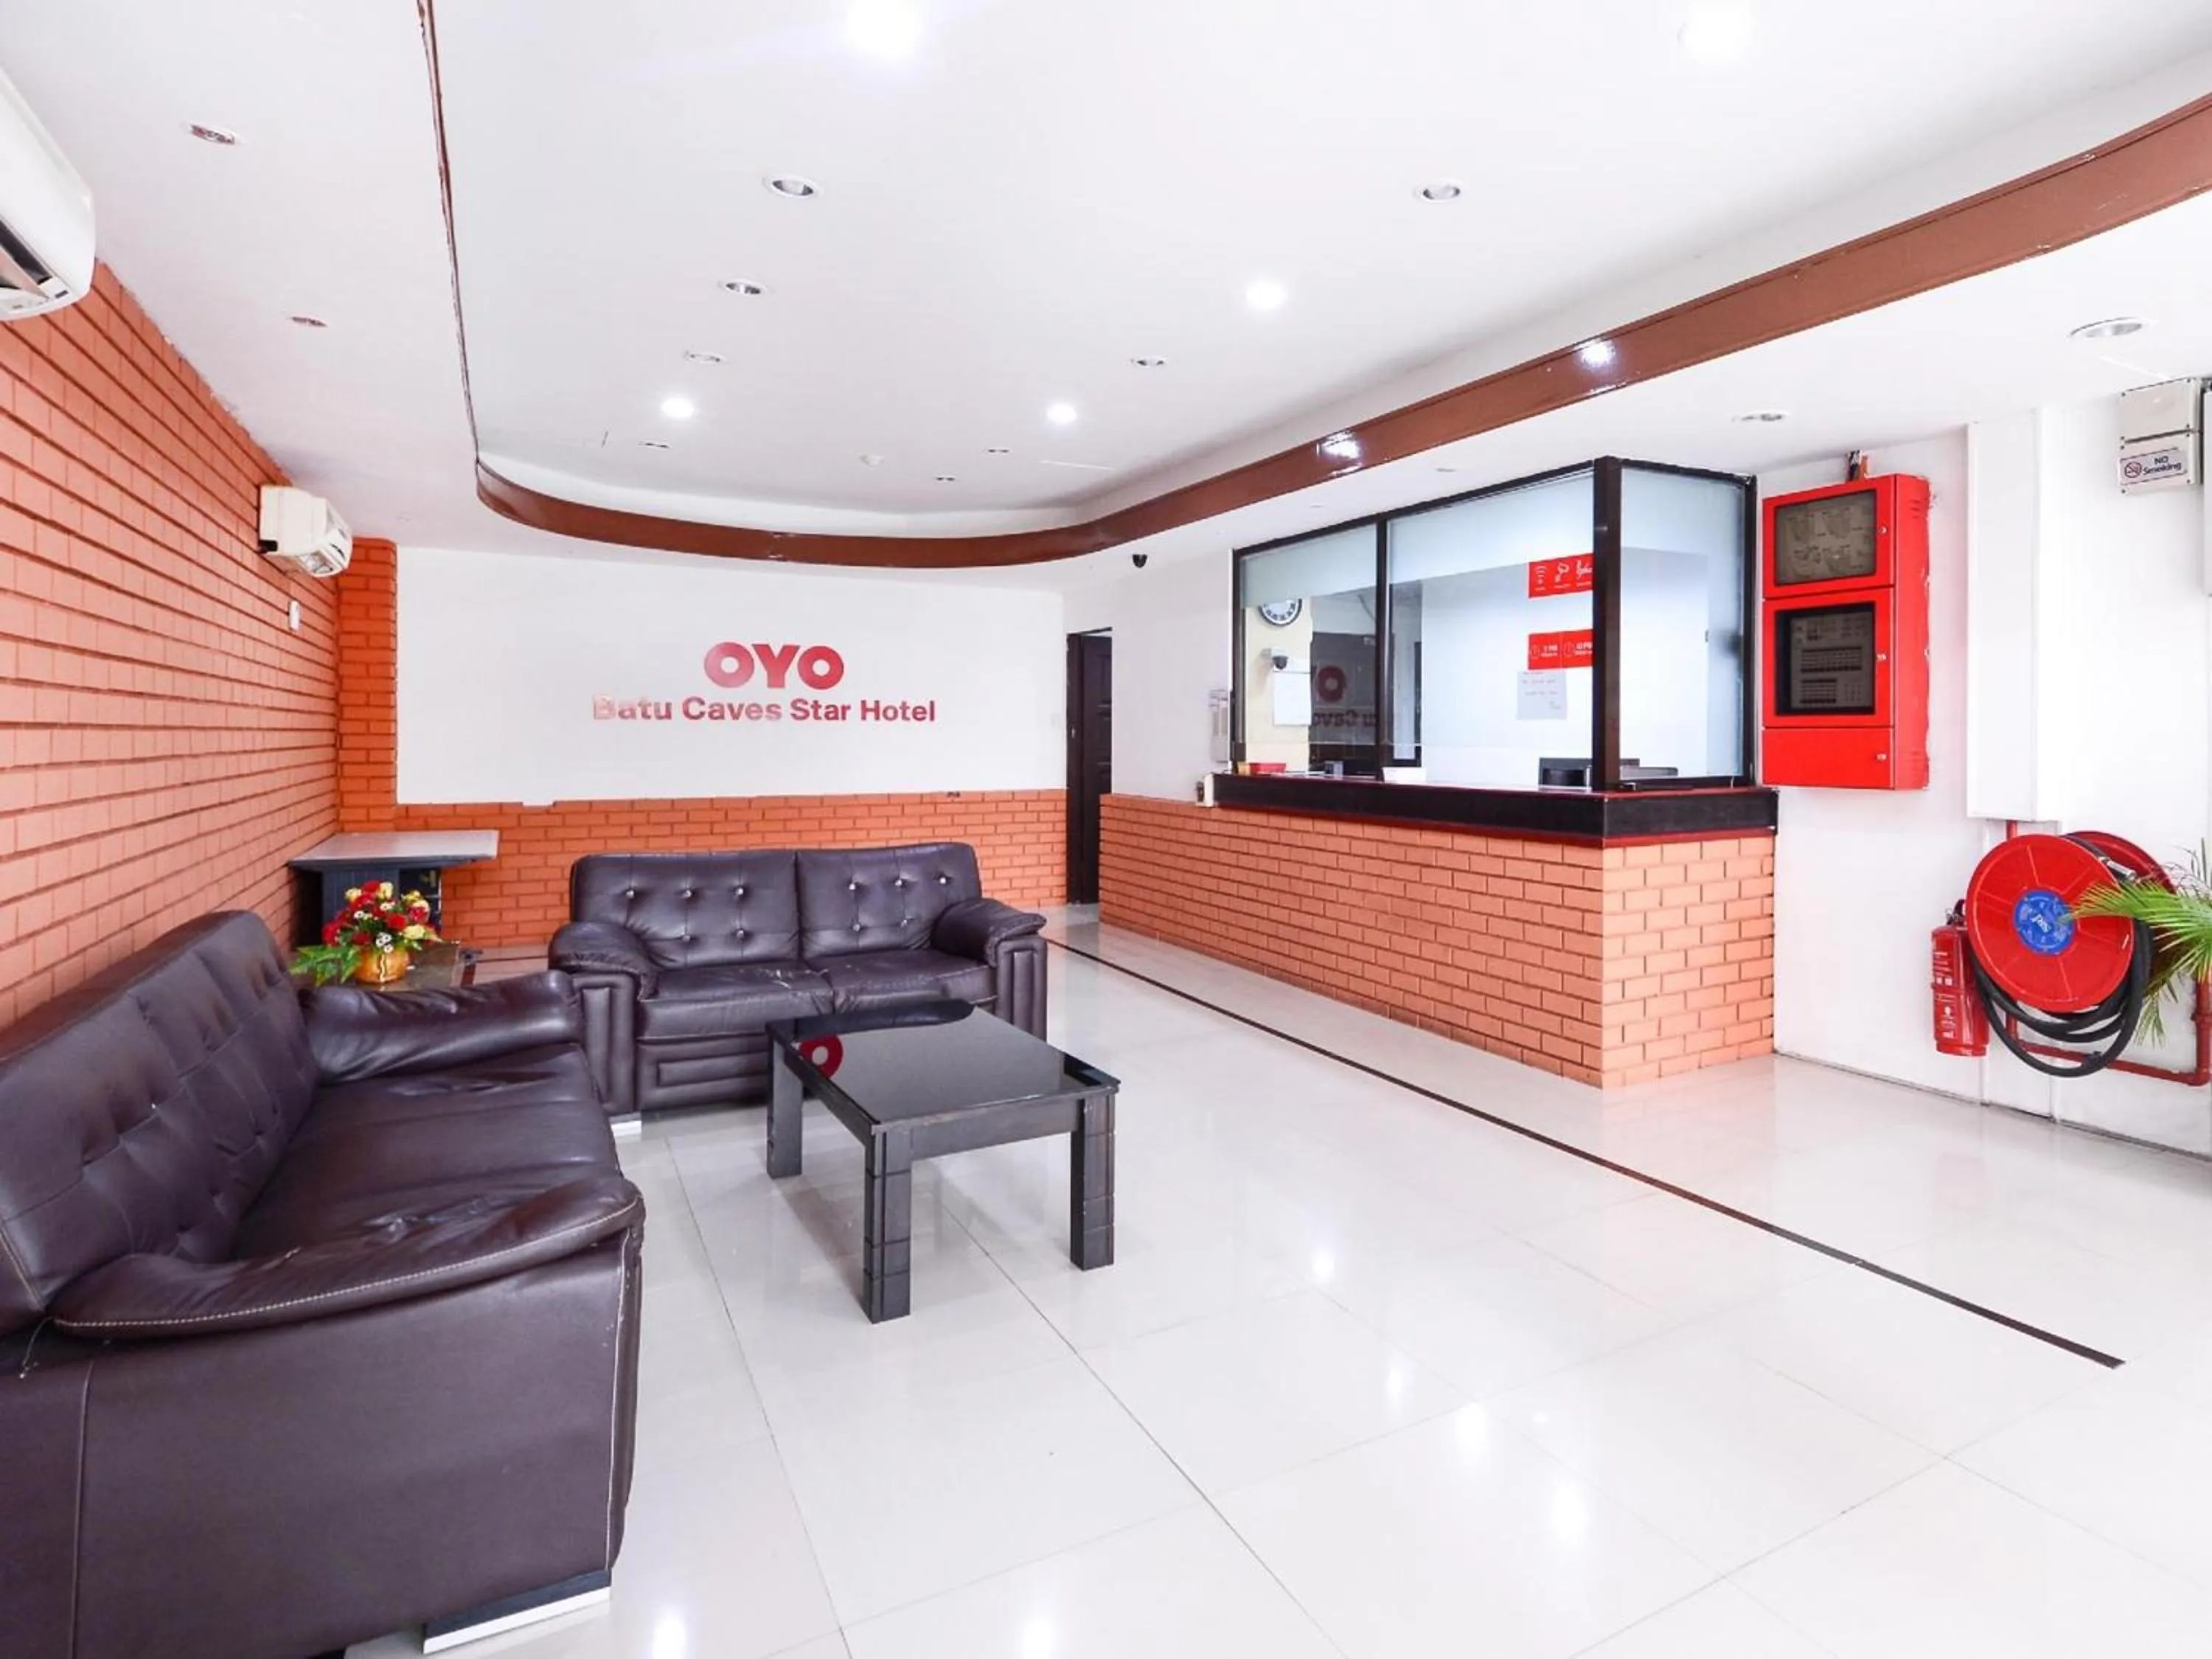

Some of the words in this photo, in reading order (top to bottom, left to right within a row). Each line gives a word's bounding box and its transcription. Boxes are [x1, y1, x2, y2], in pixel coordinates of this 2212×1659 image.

[2143, 462, 2182, 476] Smoking
[2154, 456, 2169, 465] NO
[703, 641, 845, 690] OYO
[593, 694, 672, 721] Batu
[681, 696, 783, 721] Caves
[790, 698, 852, 721] Star
[860, 700, 936, 722] Hotel
